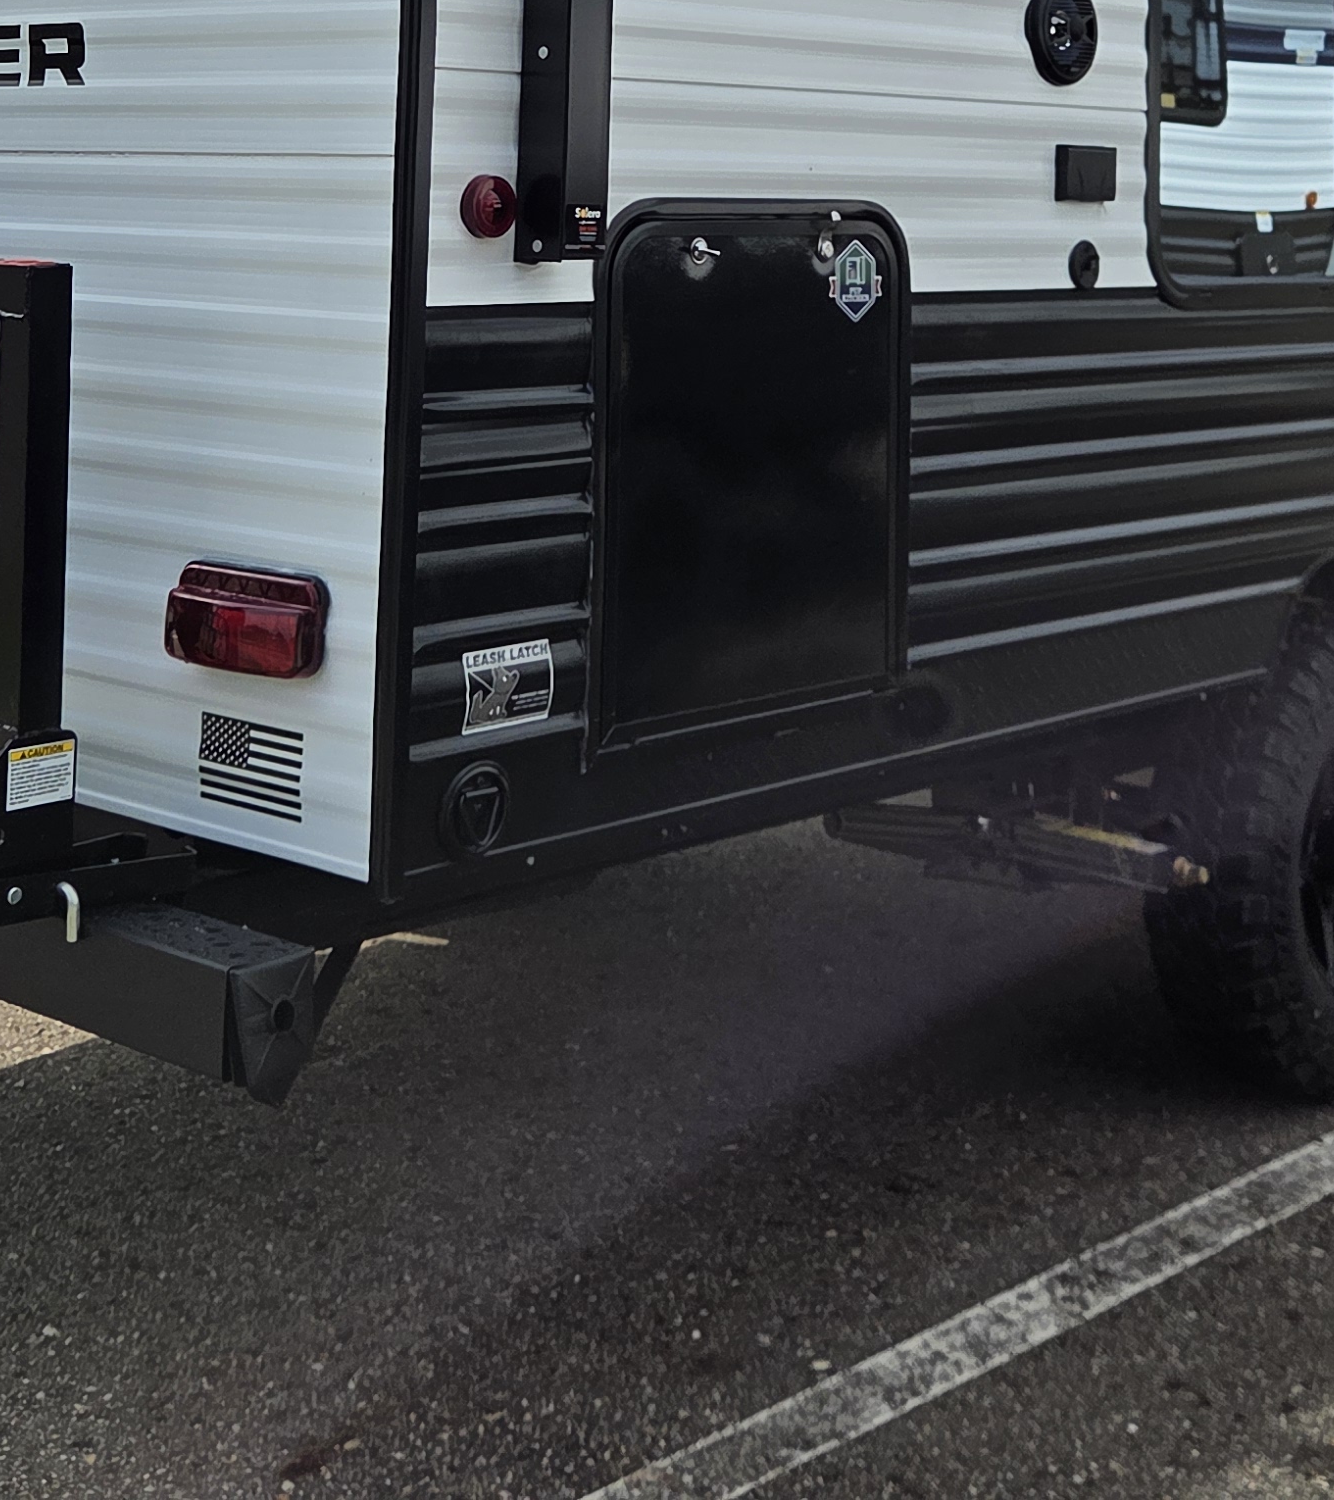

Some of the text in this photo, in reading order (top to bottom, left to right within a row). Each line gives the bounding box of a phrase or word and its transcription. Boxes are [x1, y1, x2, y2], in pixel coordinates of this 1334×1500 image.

[465, 642, 549, 669] LEASH LATCH
[27, 744, 65, 759] CAUTION
